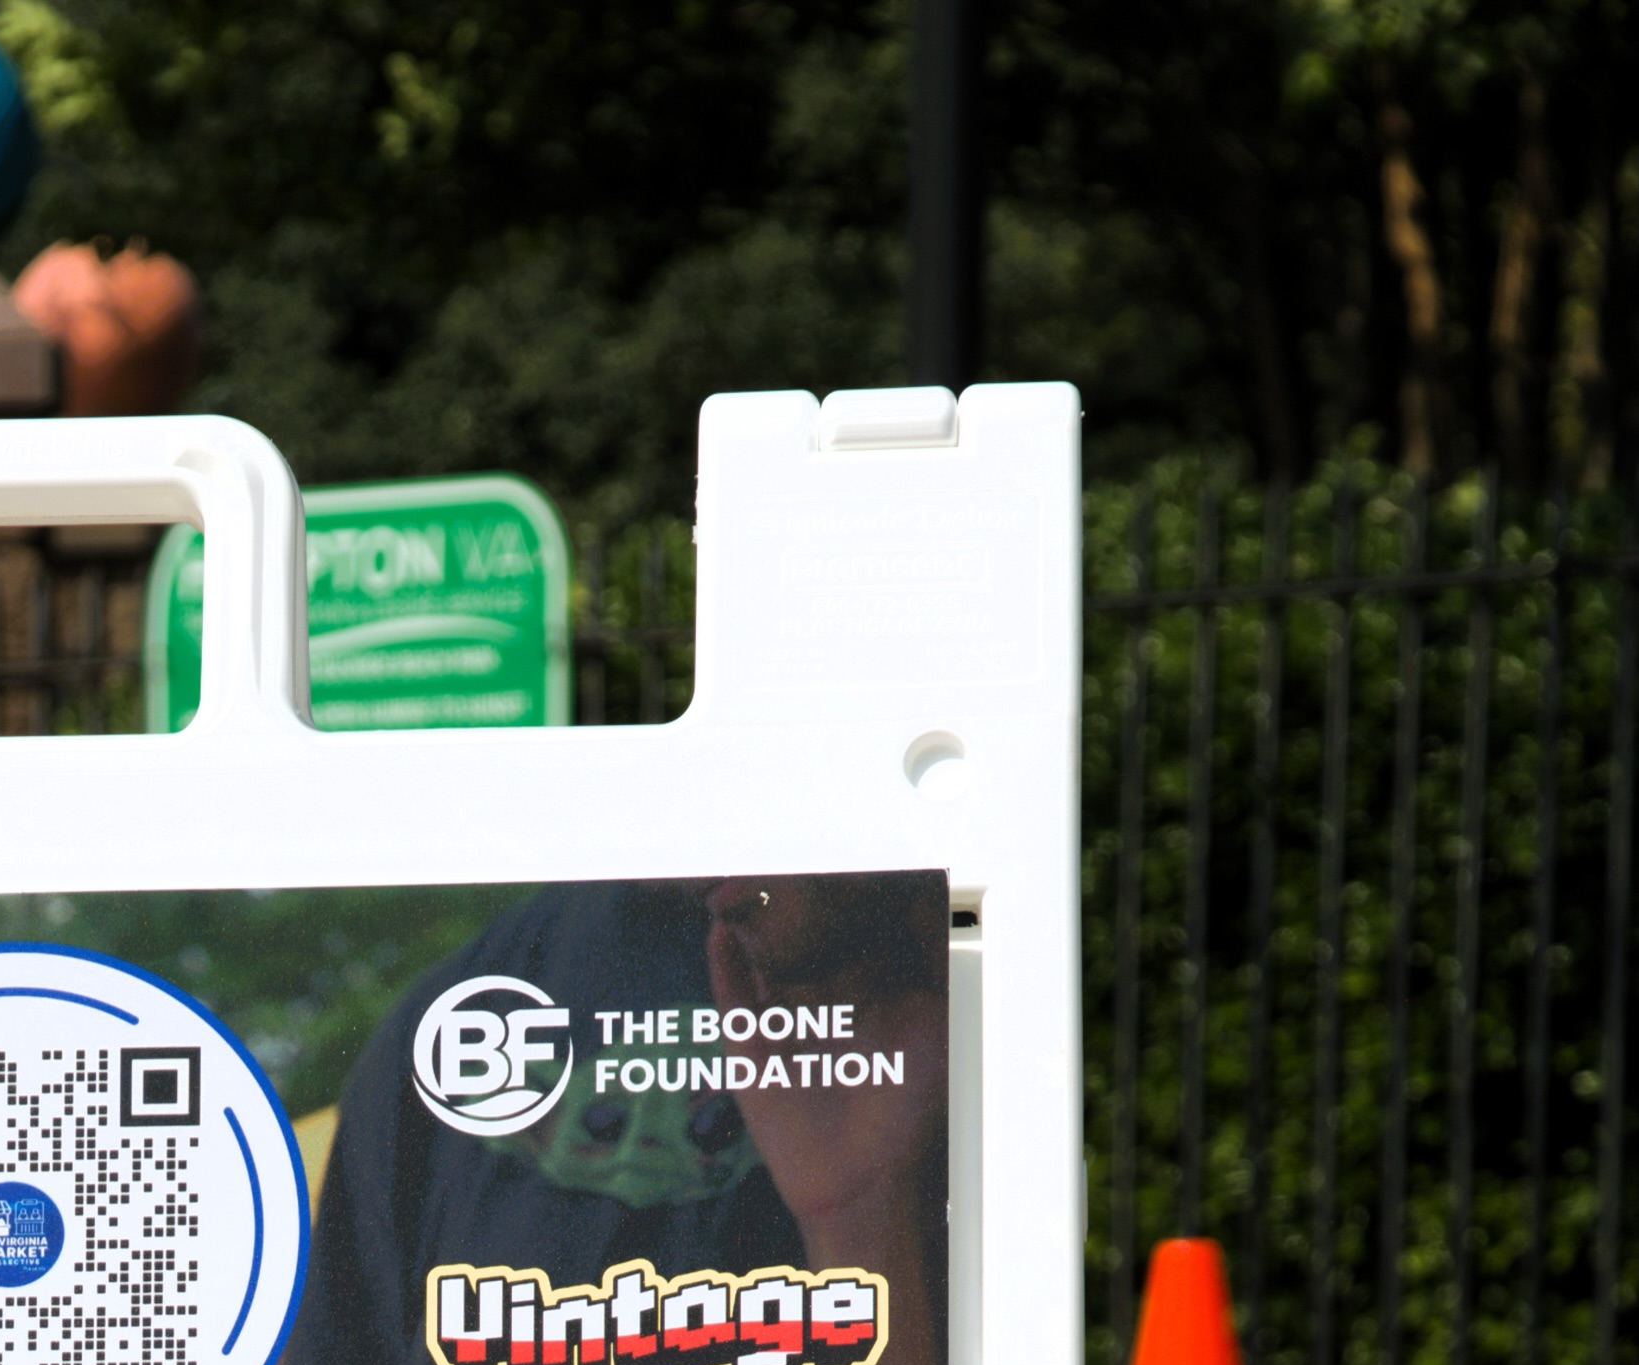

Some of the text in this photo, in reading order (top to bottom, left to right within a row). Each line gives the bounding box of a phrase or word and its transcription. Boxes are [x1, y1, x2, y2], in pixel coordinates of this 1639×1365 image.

[595, 1004, 856, 1046] THE BOONE
[594, 1050, 906, 1094] FOUNDATION
